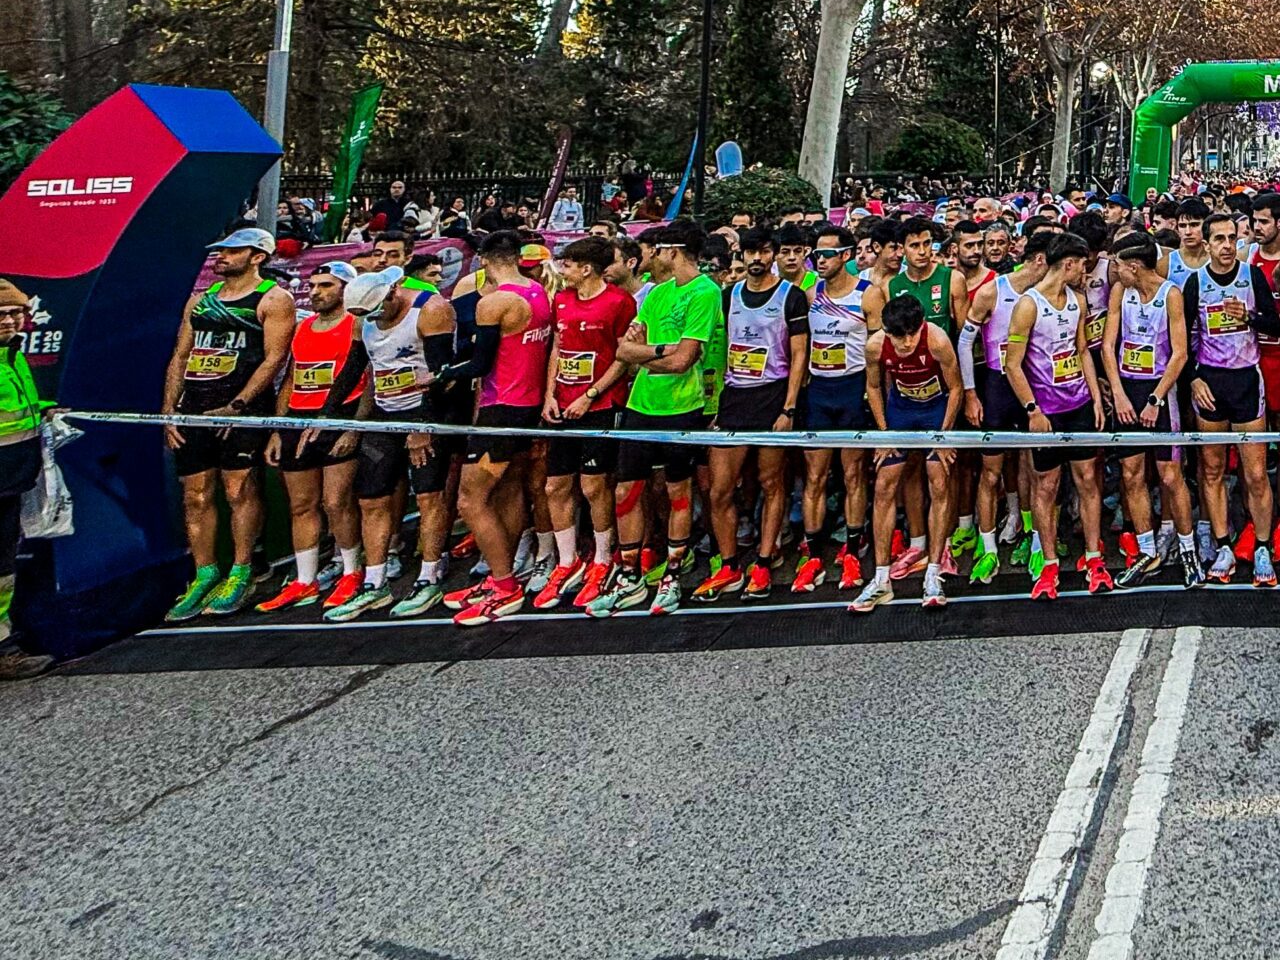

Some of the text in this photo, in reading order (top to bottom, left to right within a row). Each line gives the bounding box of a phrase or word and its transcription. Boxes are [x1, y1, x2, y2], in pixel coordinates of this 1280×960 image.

[27, 177, 133, 196] SOLISS
[1089, 322, 1101, 333] 73
[43, 330, 63, 341] 20
[42, 342, 61, 353] 25
[740, 353, 748, 363] 2
[822, 351, 828, 360] 9
[1130, 352, 1140, 361] 97
[199, 357, 221, 367] 158
[563, 360, 580, 370] 354
[1063, 357, 1077, 370] 412
[303, 371, 316, 380] 41
[382, 376, 400, 387] 261
